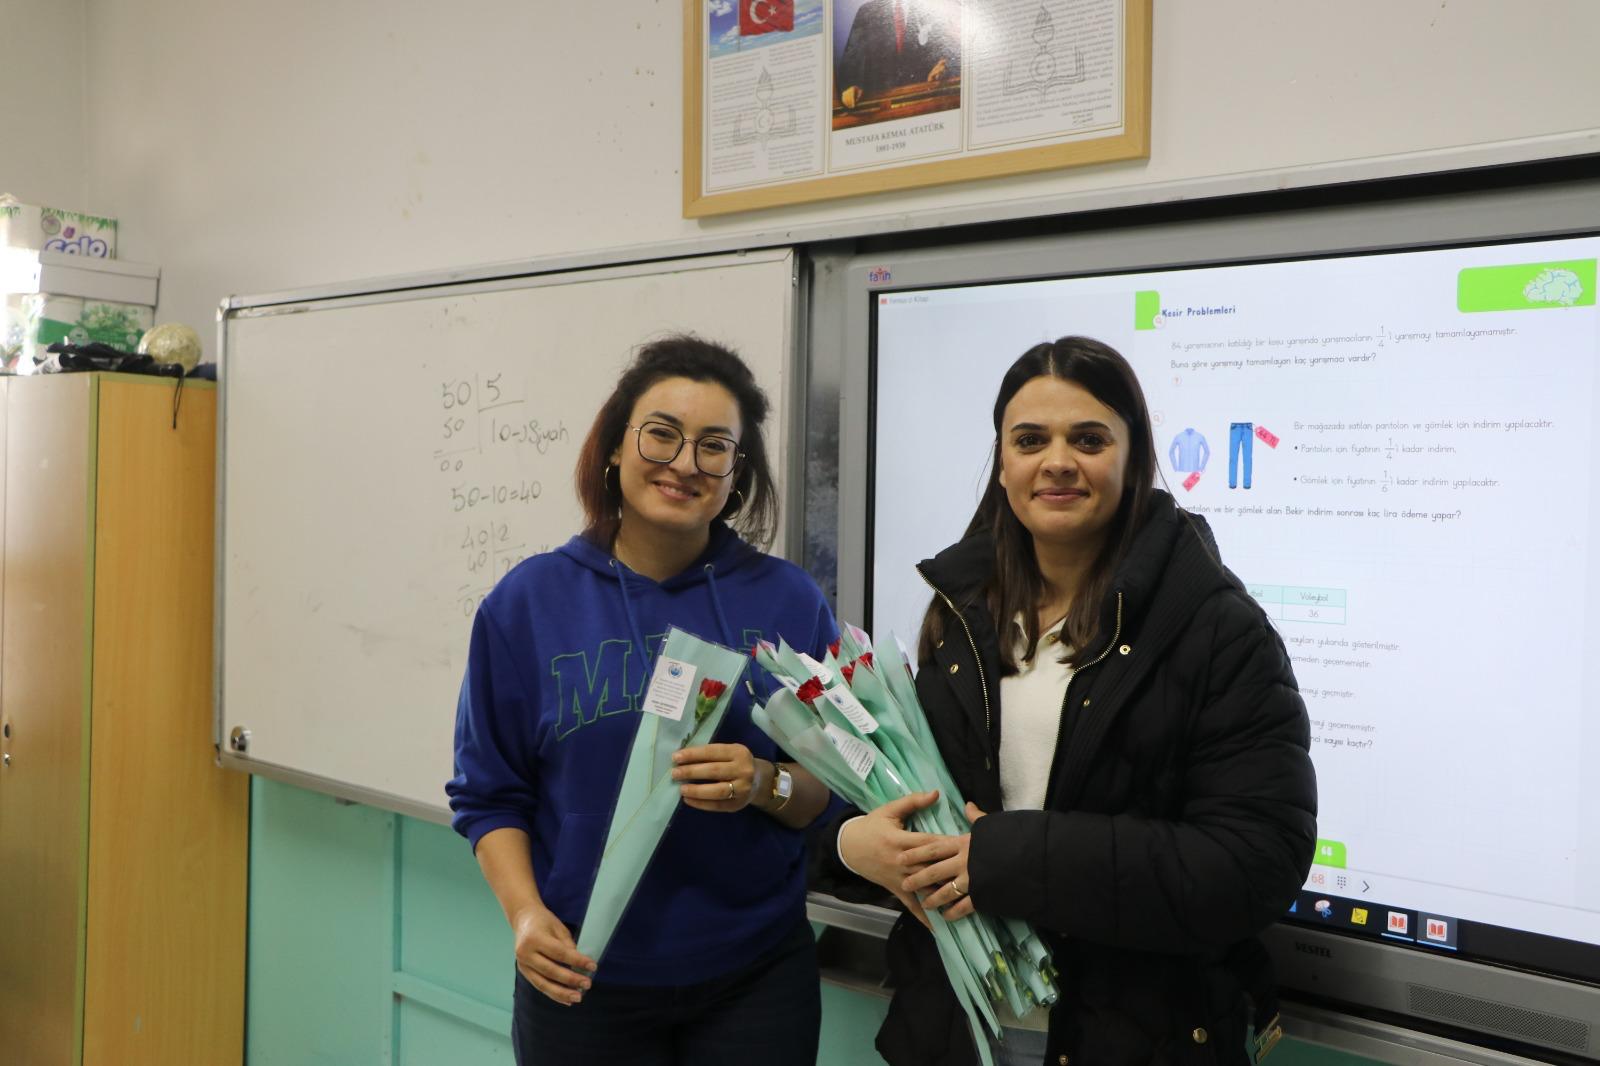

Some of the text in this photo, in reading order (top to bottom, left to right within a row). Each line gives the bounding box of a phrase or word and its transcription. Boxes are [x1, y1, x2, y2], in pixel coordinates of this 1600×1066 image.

[845, 122, 945, 146] MUSTAFA KEMAL ATATÜRK
[1162, 305, 1236, 318] Kesir Problemleri
[1170, 360, 1189, 369] Buna
[1191, 360, 1208, 371] göre
[442, 372, 502, 410] 50 5
[443, 417, 466, 440] 50
[1184, 504, 1211, 513] antolon
[461, 523, 510, 550] 40 2
[467, 549, 488, 575] 40
[1311, 873, 1325, 885] 68
[1295, 941, 1333, 959] VESTEL
